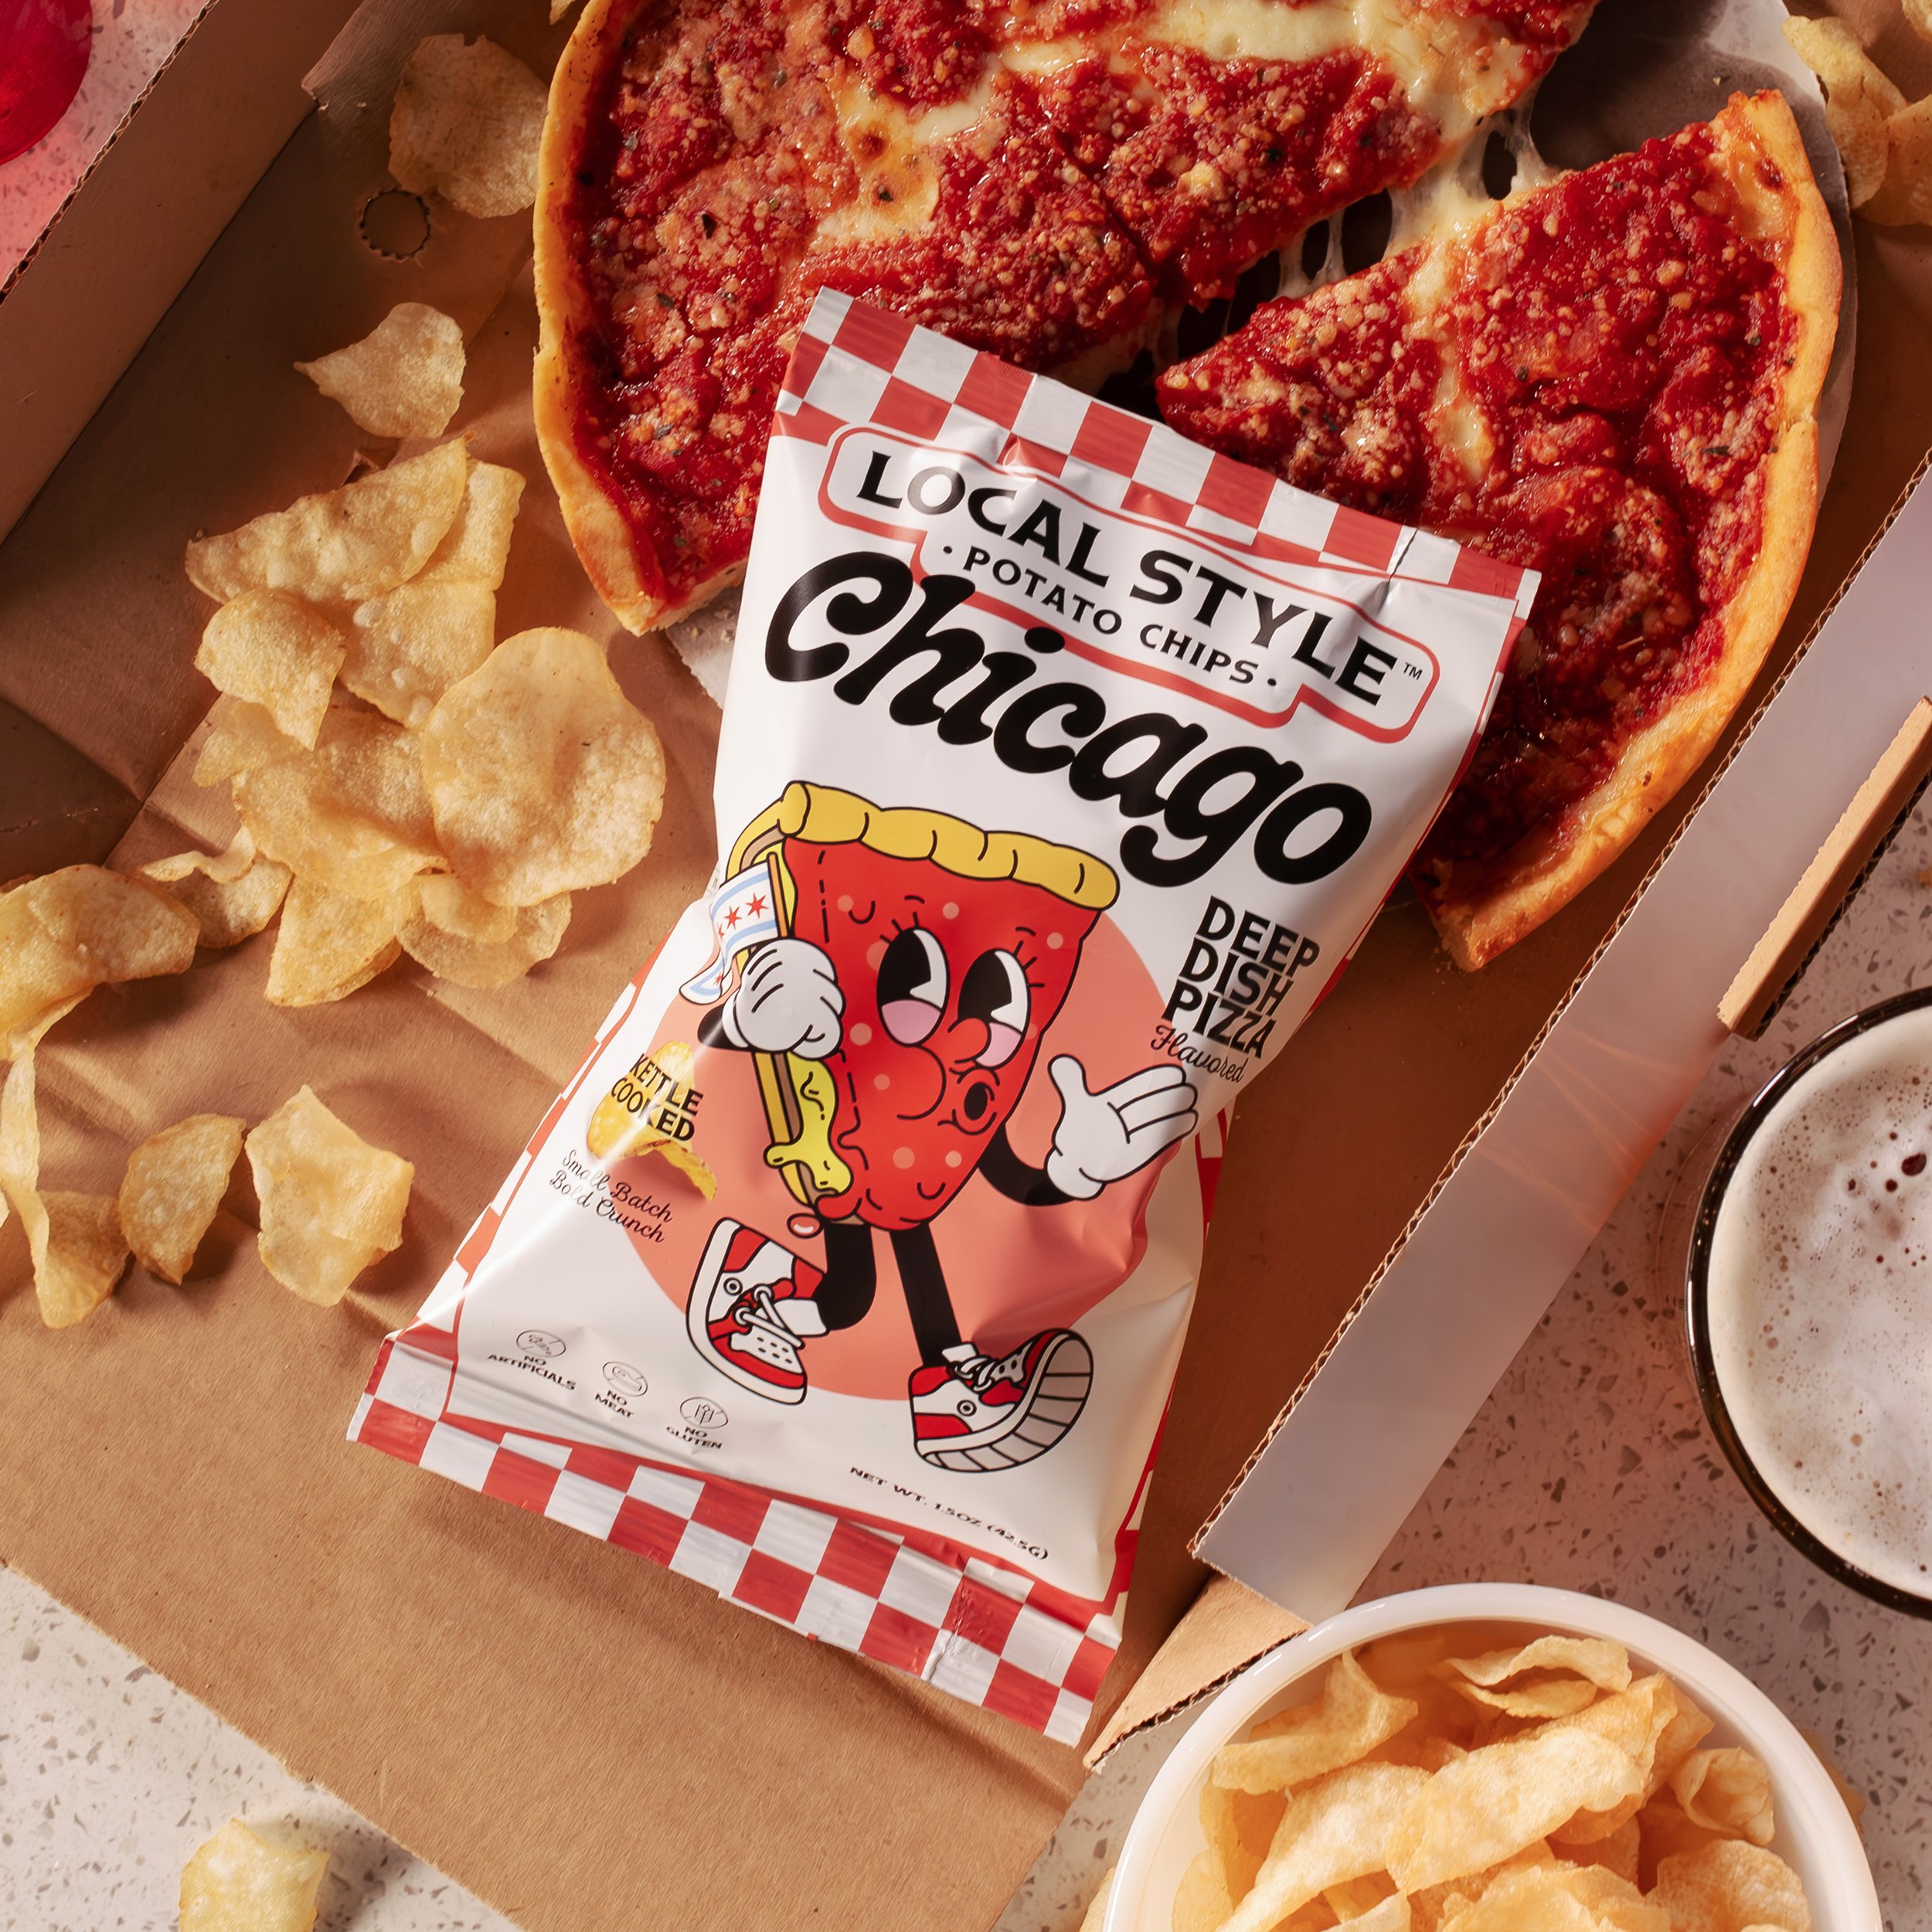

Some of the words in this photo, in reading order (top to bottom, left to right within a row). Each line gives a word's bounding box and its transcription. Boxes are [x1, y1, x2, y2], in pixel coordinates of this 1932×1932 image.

[857, 451, 1110, 588] LOCAL
[1129, 549, 1397, 706] STYLE
[963, 545, 1122, 636] POTATO
[1139, 623, 1258, 685] CHIPS
[765, 551, 1372, 887] Chicago
[1196, 895, 1320, 978] DEEP
[1179, 937, 1294, 1017] DISH
[1161, 979, 1277, 1059] PIZZA
[630, 1053, 704, 1117] KETTLE
[1150, 1025, 1249, 1083] Flavored
[611, 1077, 695, 1141] COOKED
[549, 1169, 594, 1208] Bold
[596, 1196, 665, 1243] Crunch
[563, 1149, 611, 1191] Small
[610, 1182, 673, 1223] Batch
[488, 1354, 577, 1391] ARTIFICIALS
[523, 1355, 546, 1366] NO
[594, 1393, 634, 1418] MEAT
[607, 1390, 628, 1406] NO
[684, 1426, 707, 1438] NO
[666, 1426, 723, 1450] GLUTEN
[849, 1467, 888, 1486] NET
[893, 1485, 927, 1505] WT.
[987, 1524, 1049, 1560] (42.5G)
